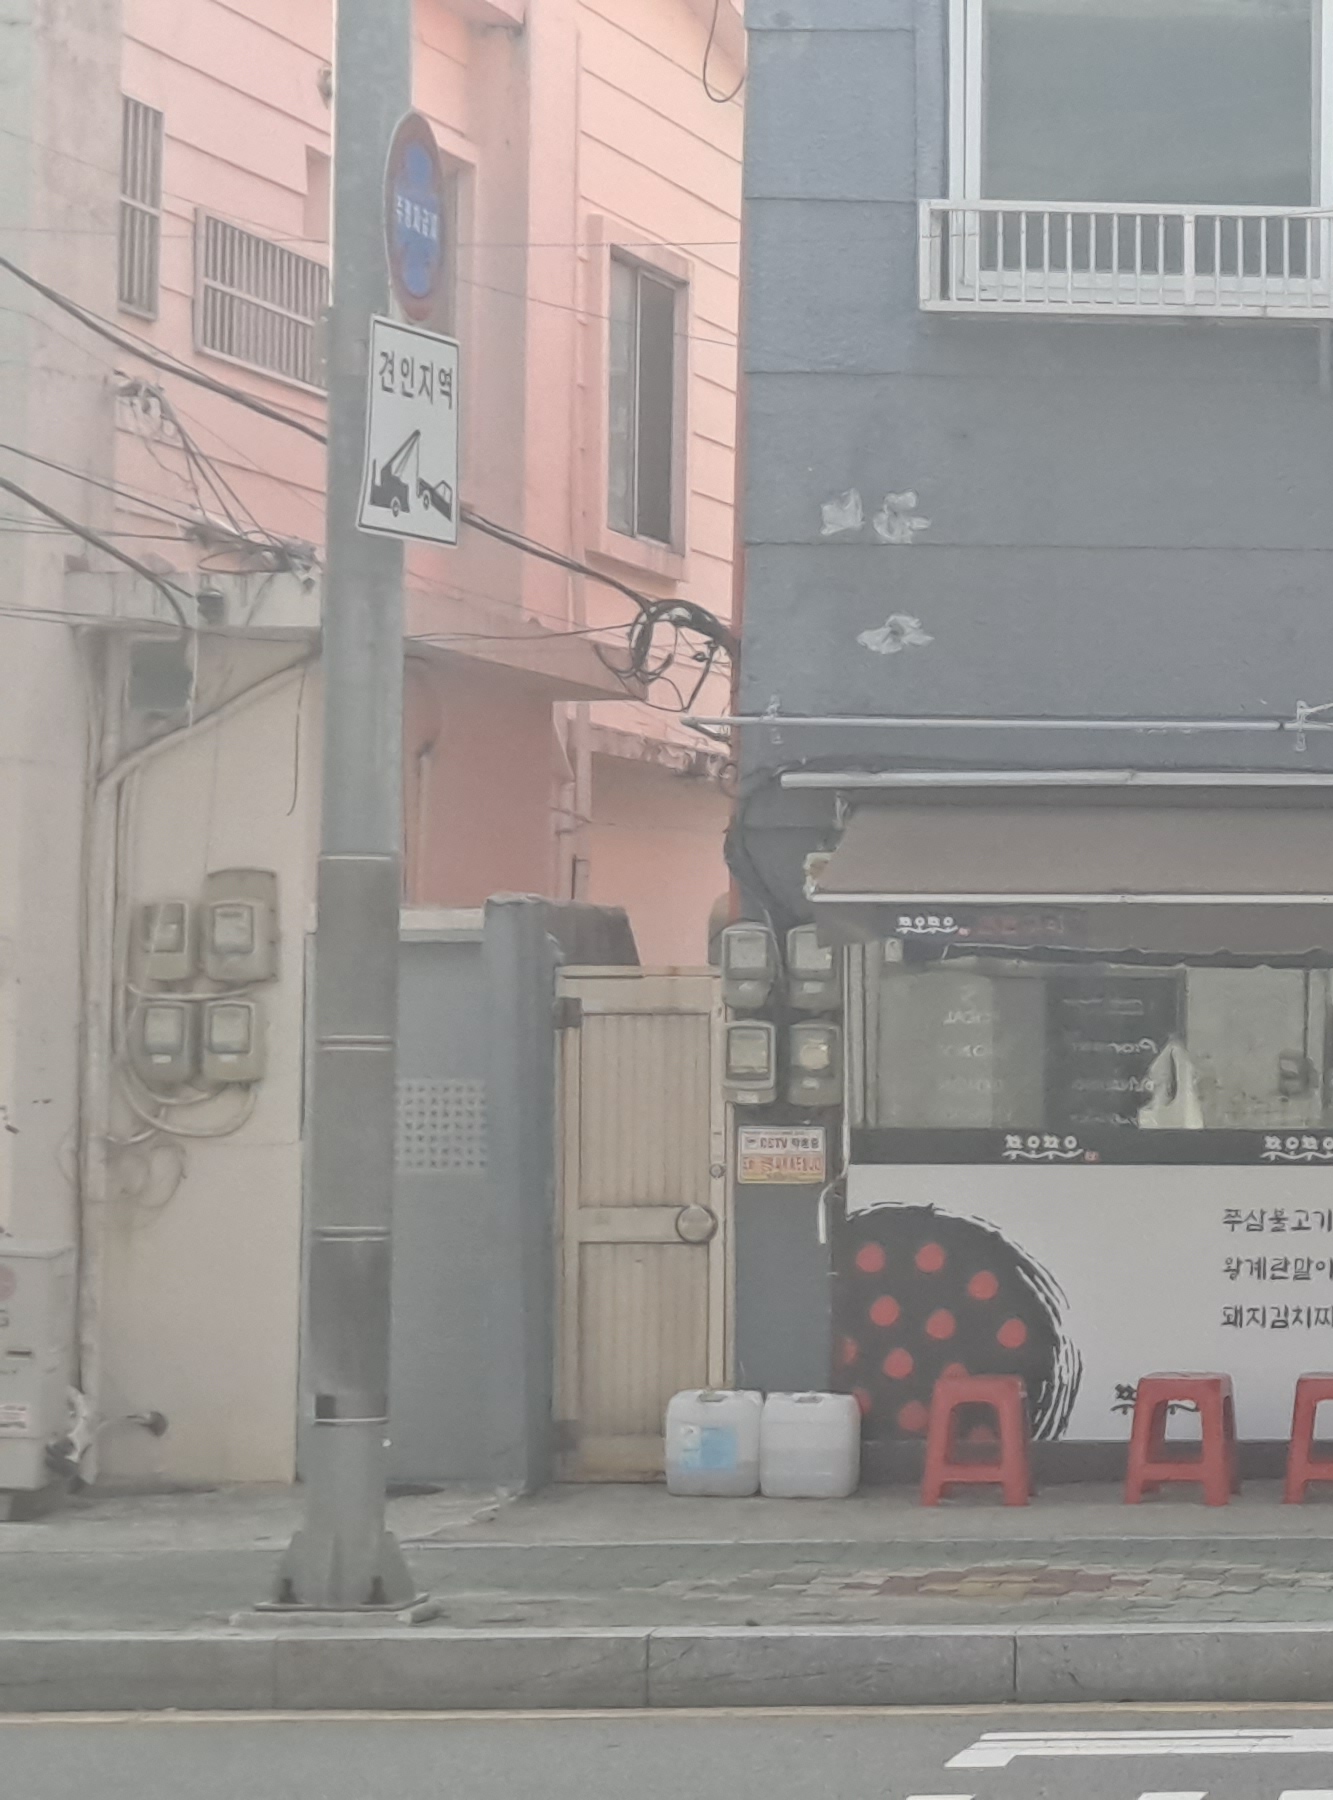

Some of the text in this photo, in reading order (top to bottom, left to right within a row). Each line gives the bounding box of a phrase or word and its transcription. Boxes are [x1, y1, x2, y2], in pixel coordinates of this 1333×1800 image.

[378, 348, 454, 410] 견인지역
[1222, 1208, 1333, 1233] 쭈삼불고기
[1222, 1256, 1333, 1282] 왕계란말이
